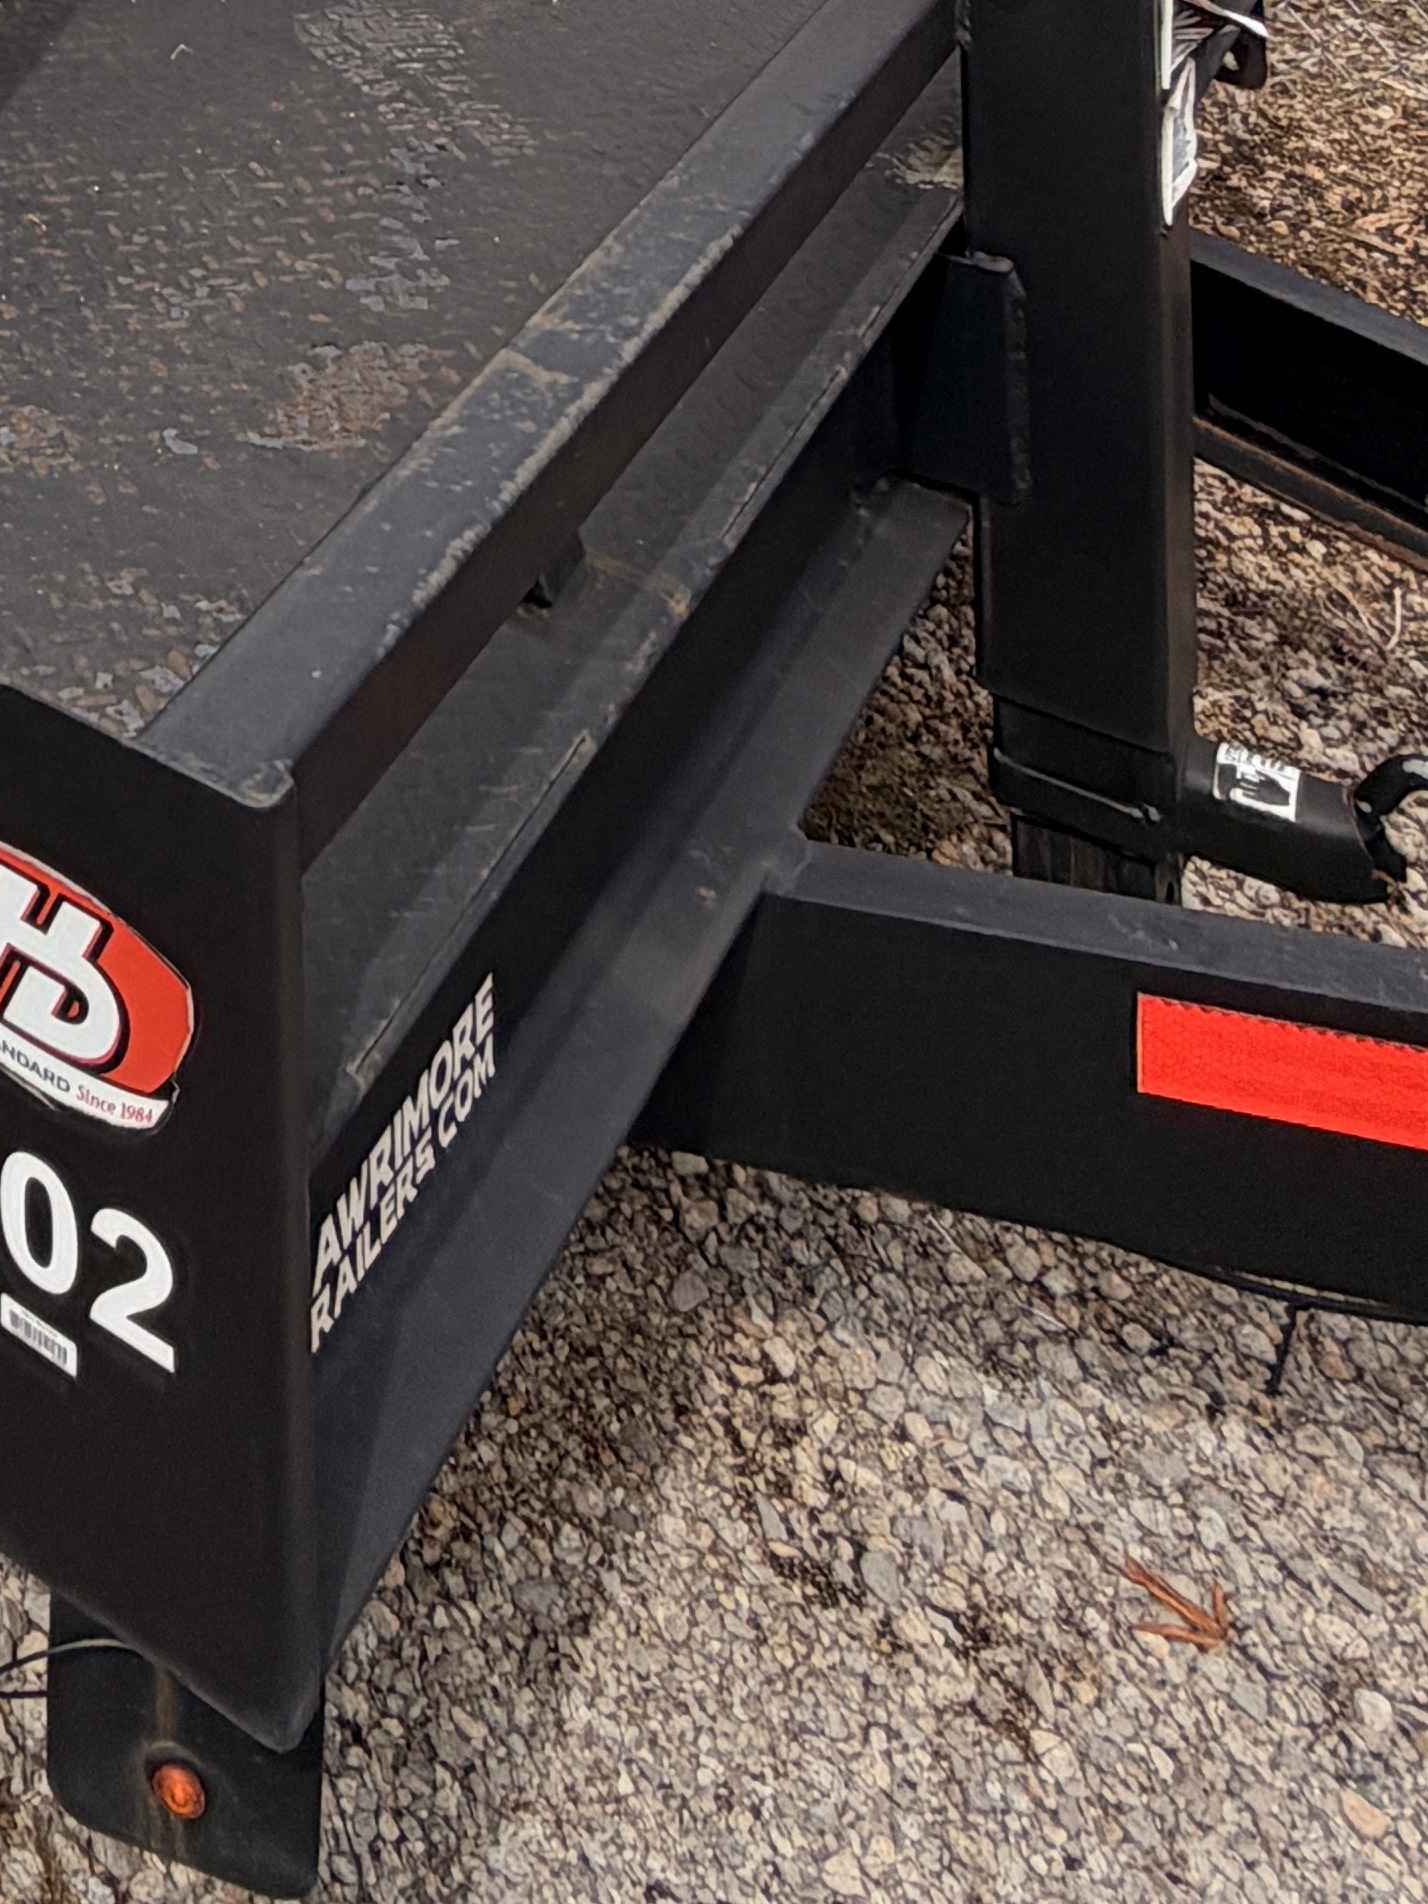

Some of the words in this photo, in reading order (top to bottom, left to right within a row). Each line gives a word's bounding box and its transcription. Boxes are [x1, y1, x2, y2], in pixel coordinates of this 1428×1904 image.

[120, 1102, 154, 1124] 1984
[313, 972, 494, 1298] AWRIMORE
[310, 1126, 436, 1354] RAILERS
